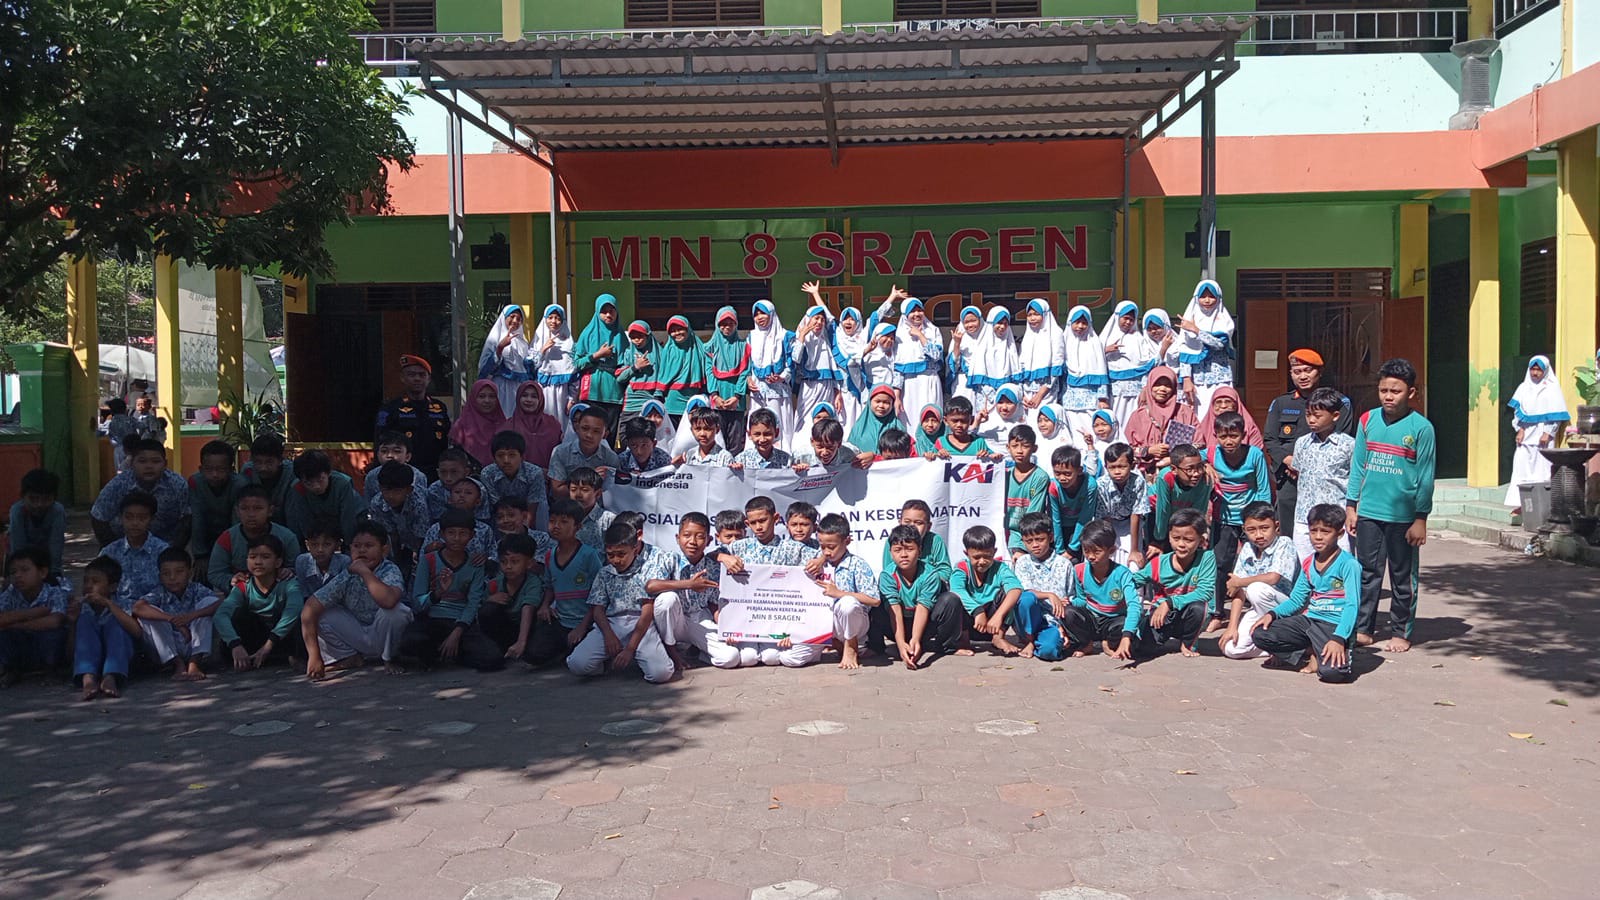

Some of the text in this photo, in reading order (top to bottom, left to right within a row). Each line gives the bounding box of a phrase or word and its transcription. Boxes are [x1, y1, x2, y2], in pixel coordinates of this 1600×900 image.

[590, 225, 1089, 281] MIN 8 SRAGEN
[943, 462, 994, 484] KAI
[636, 480, 689, 489] Indonesia
[865, 506, 981, 522] KESEMATAN
[774, 614, 801, 622] SRAGEN
